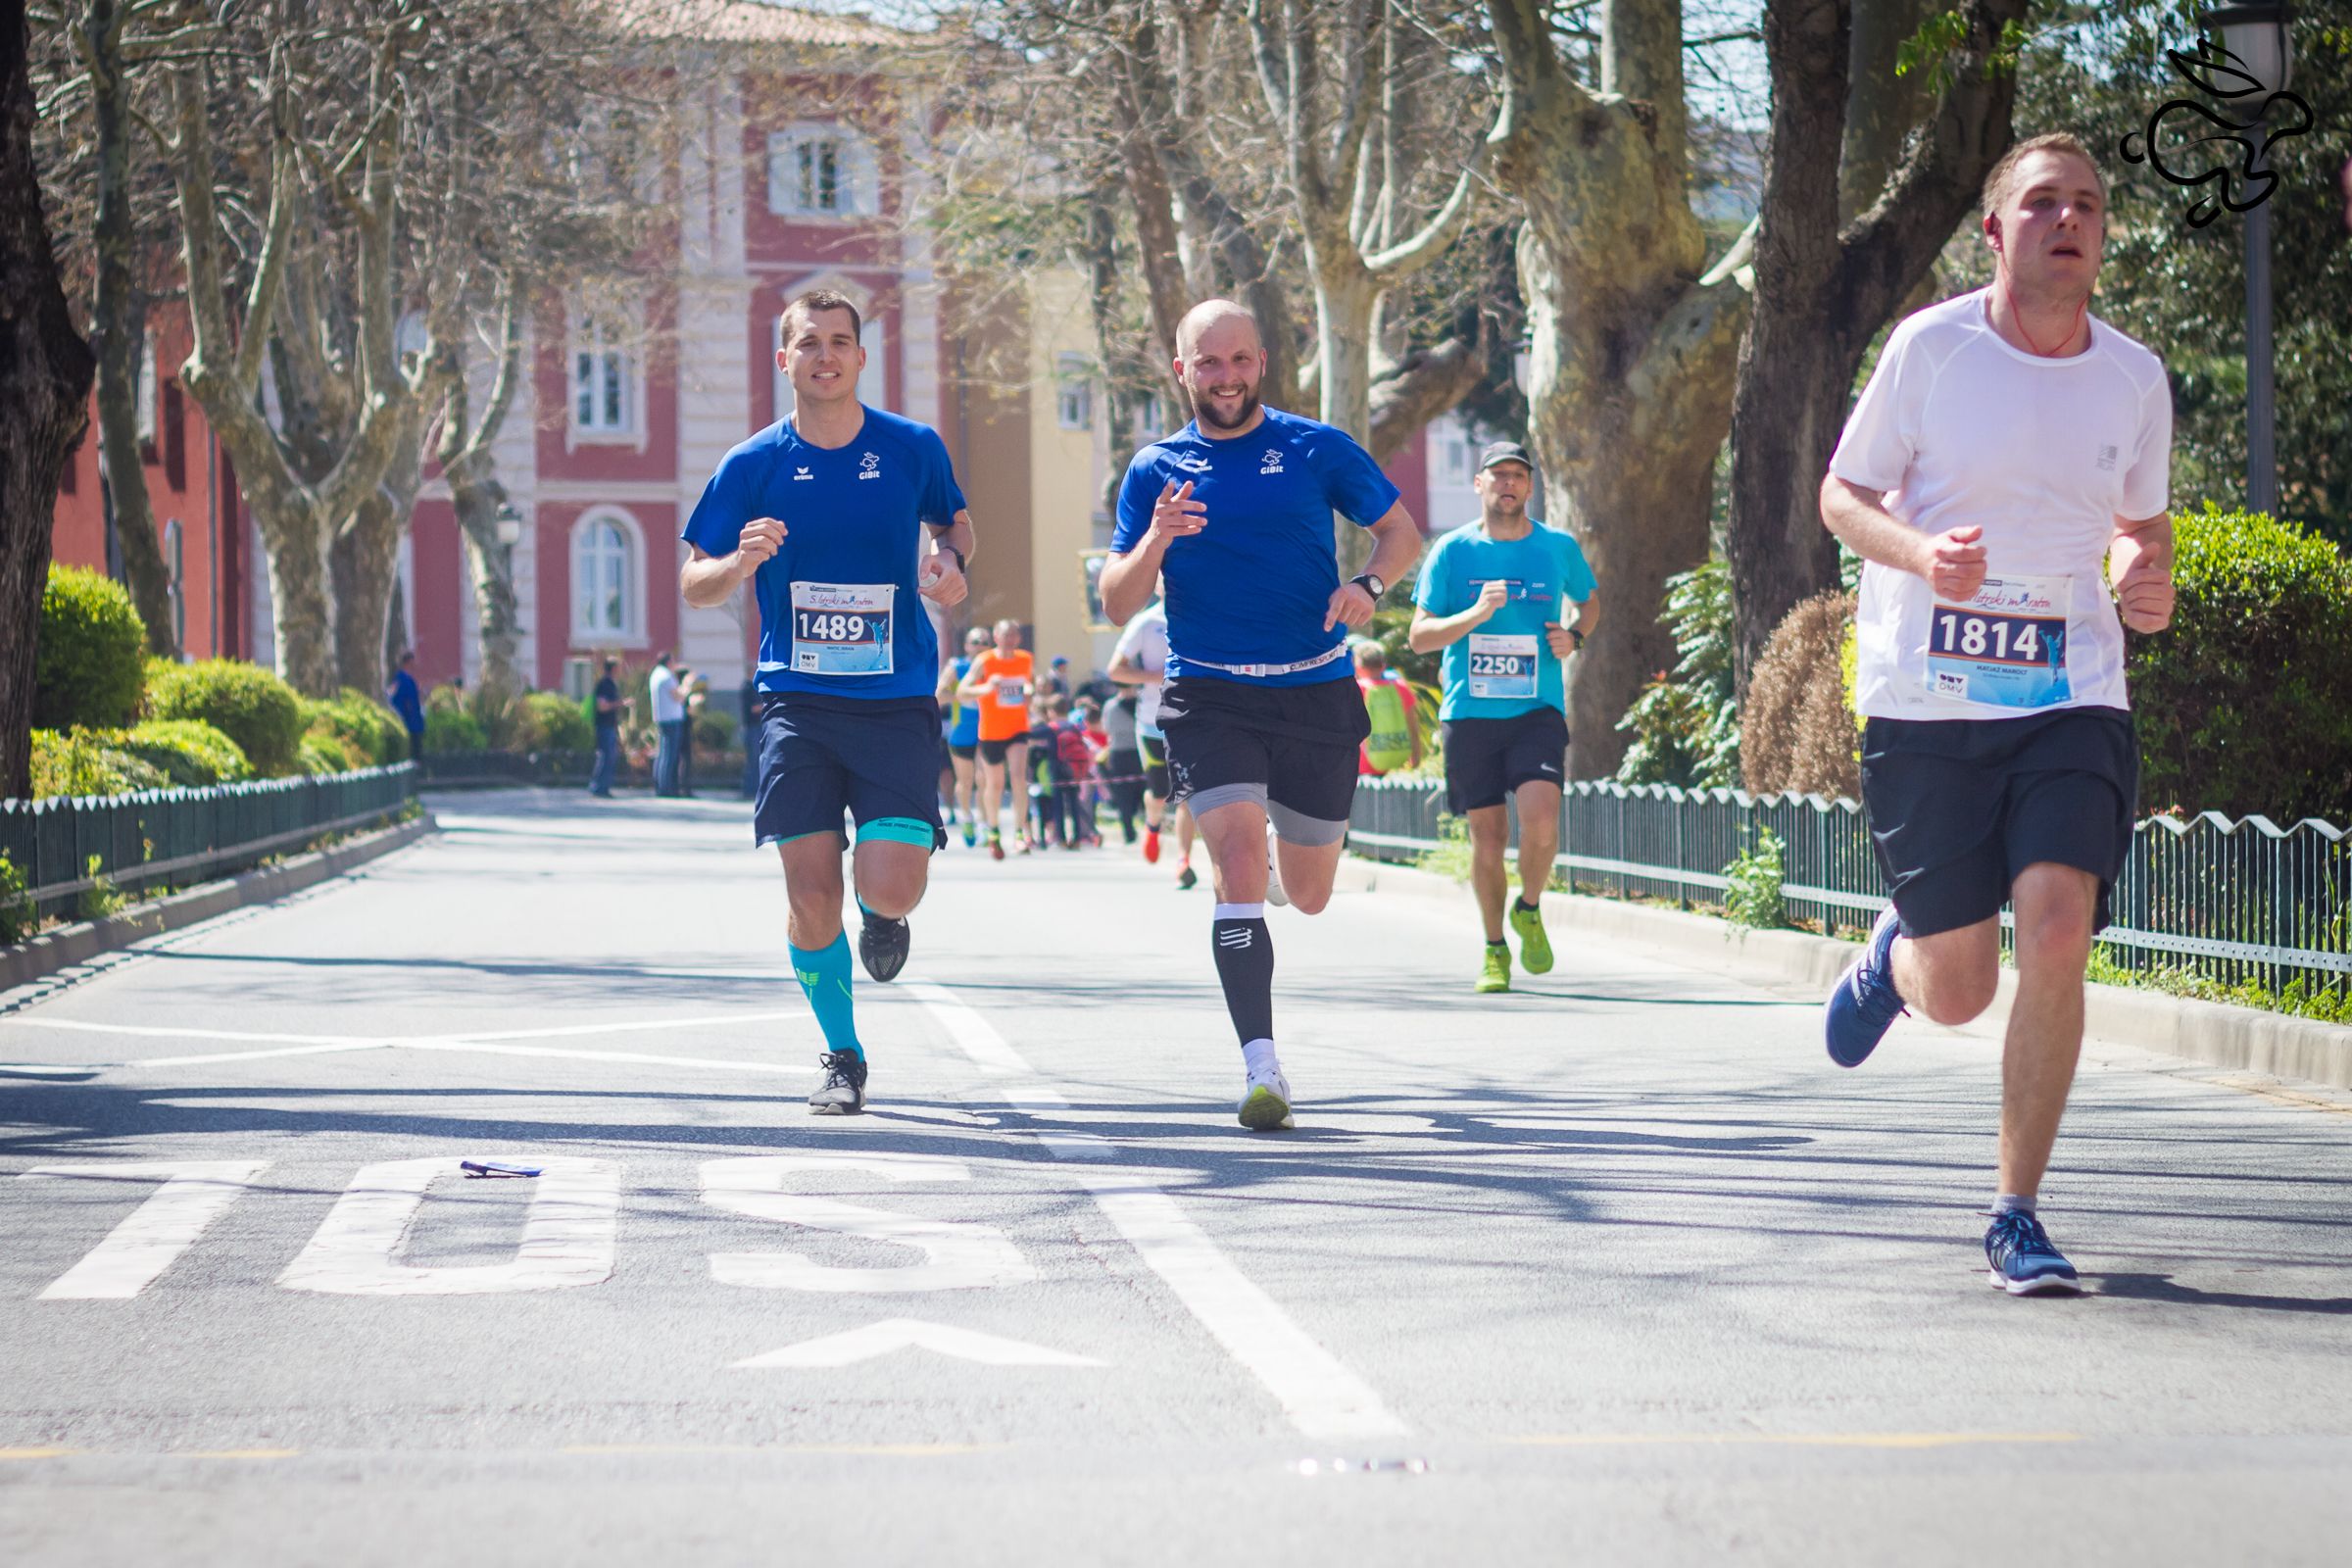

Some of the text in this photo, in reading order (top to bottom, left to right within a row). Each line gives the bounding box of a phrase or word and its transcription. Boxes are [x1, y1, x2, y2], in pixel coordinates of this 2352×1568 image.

[799, 612, 864, 642] 1489
[1939, 614, 2039, 662] 1814
[1472, 655, 1519, 675] 2250
[1938, 682, 1964, 694] OMV
